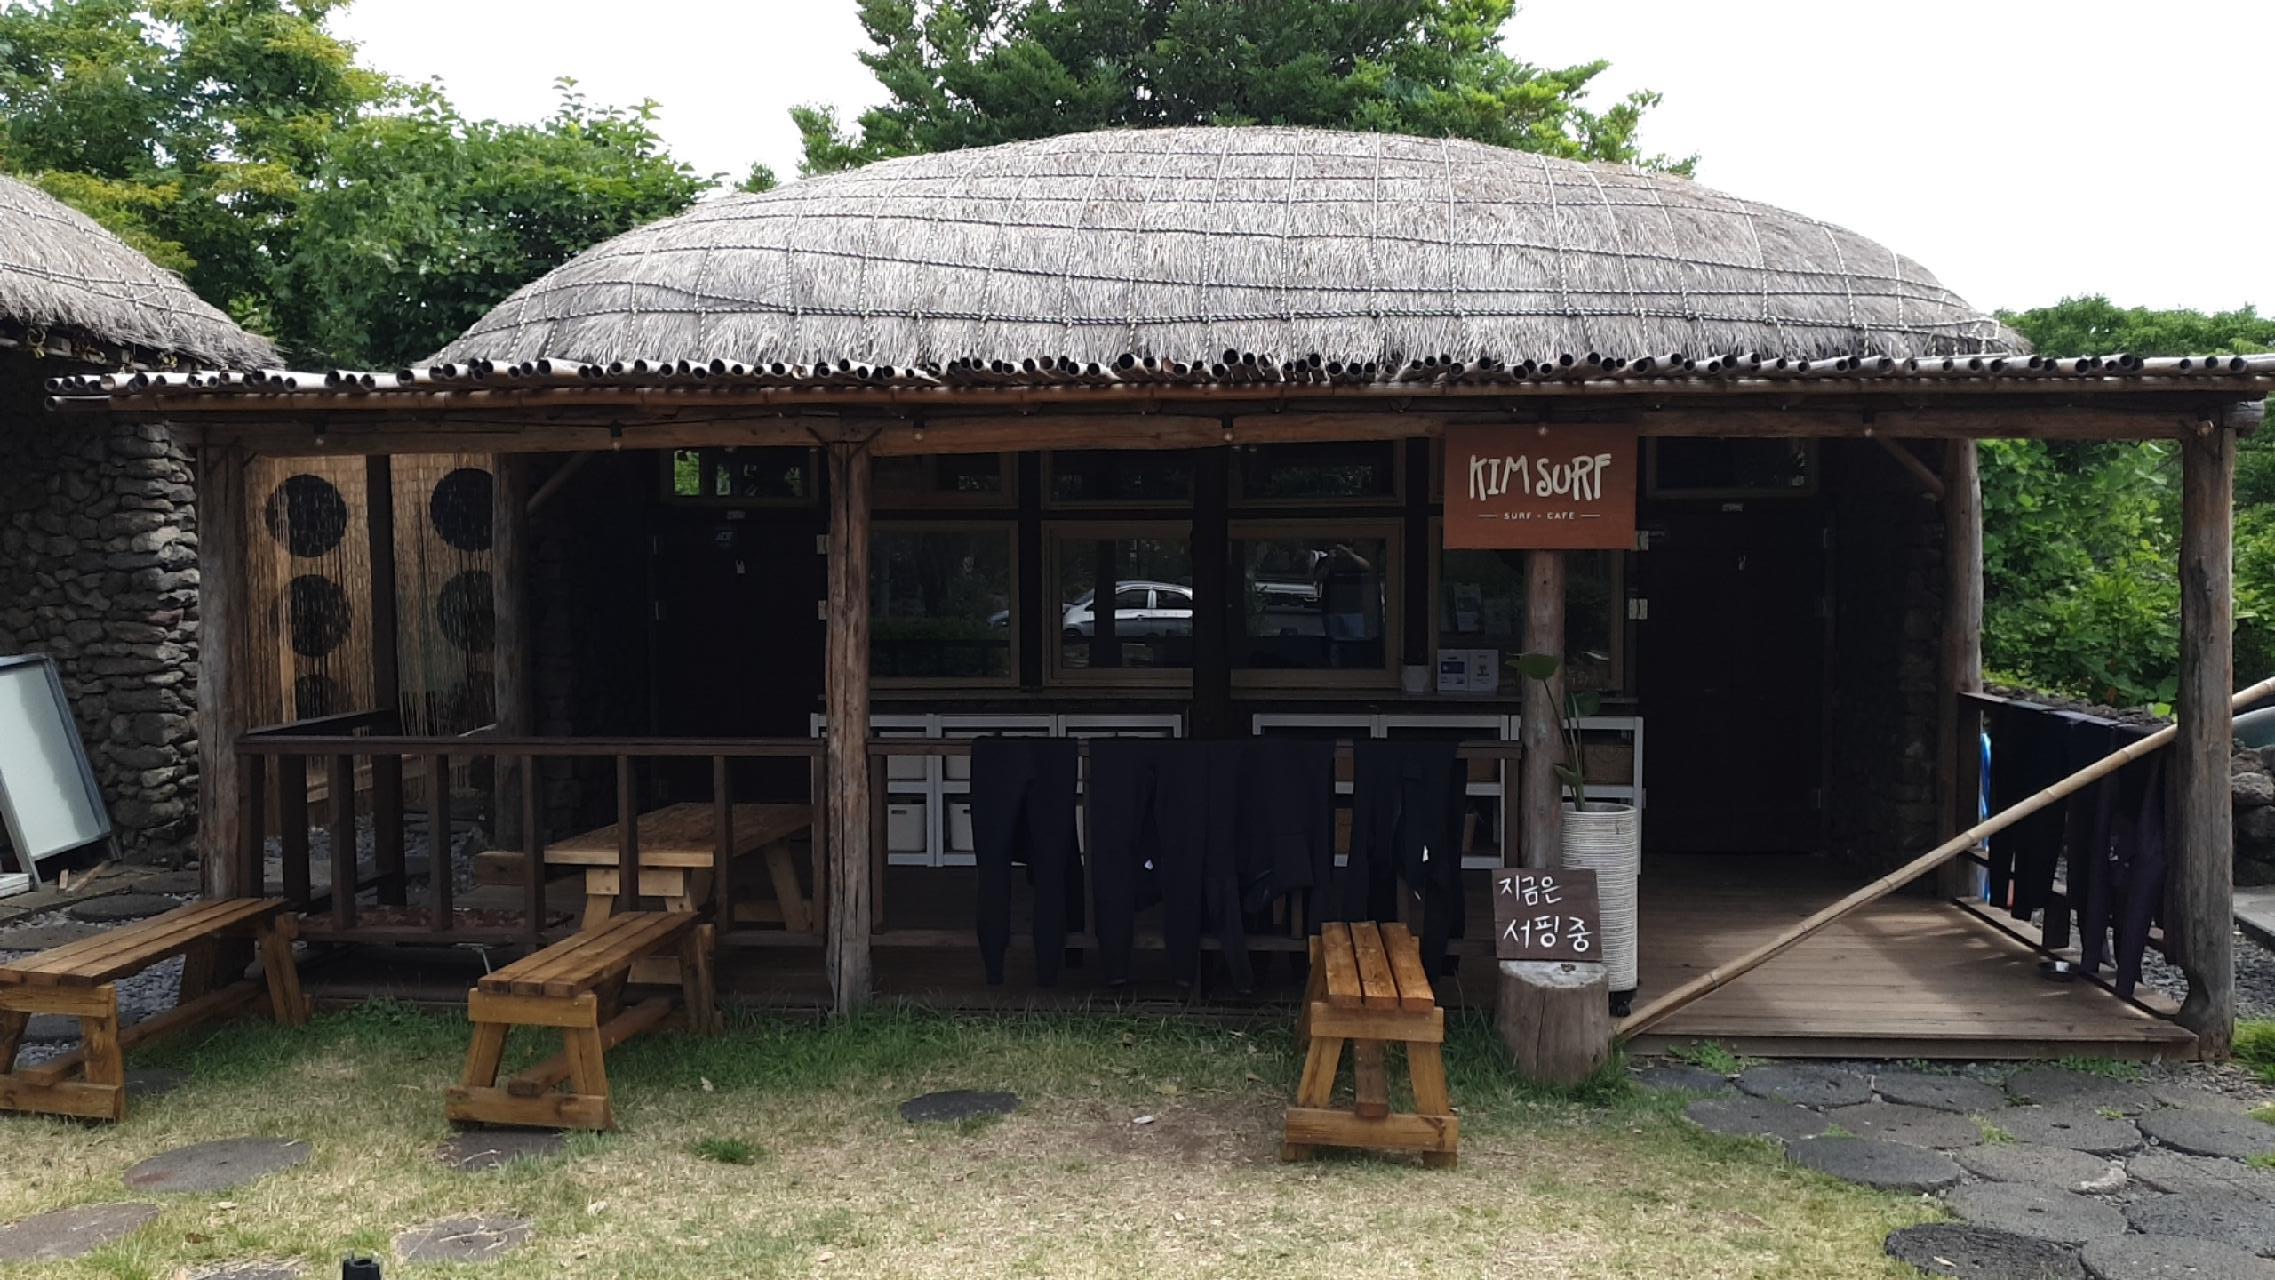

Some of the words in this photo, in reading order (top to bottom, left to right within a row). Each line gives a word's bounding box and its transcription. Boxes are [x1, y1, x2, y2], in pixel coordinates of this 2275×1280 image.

[1468, 454, 1530, 501] KIM
[1536, 453, 1611, 501] SURF
[1504, 511, 1532, 520] SURF
[1547, 511, 1576, 520] CAFE
[1498, 875, 1562, 906] 지금은
[1503, 915, 1560, 949] 서핑
[1566, 916, 1593, 953] 중
